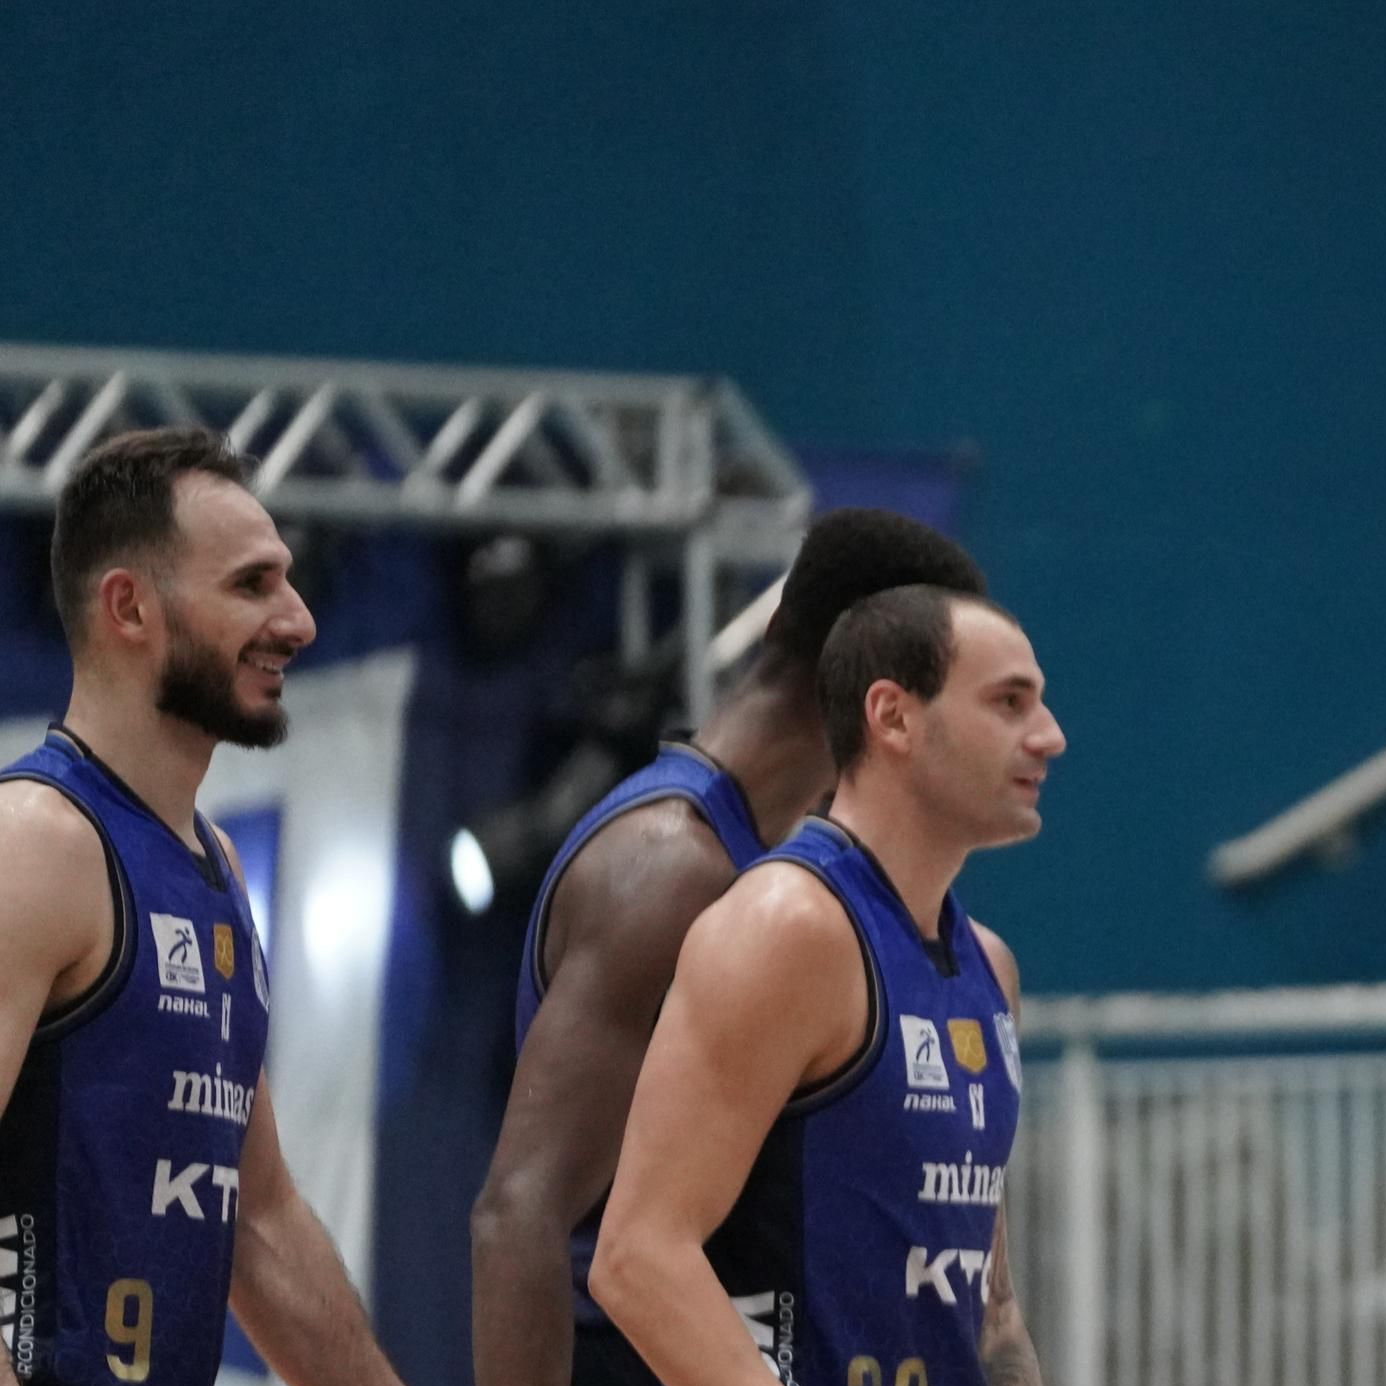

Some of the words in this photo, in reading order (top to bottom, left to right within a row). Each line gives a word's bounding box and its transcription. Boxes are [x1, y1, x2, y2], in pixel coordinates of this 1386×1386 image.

[151, 1159, 239, 1223] KT
[918, 1150, 1006, 1205] mina
[17, 1213, 36, 1362] CONDICIONADO
[105, 1278, 153, 1382] 9
